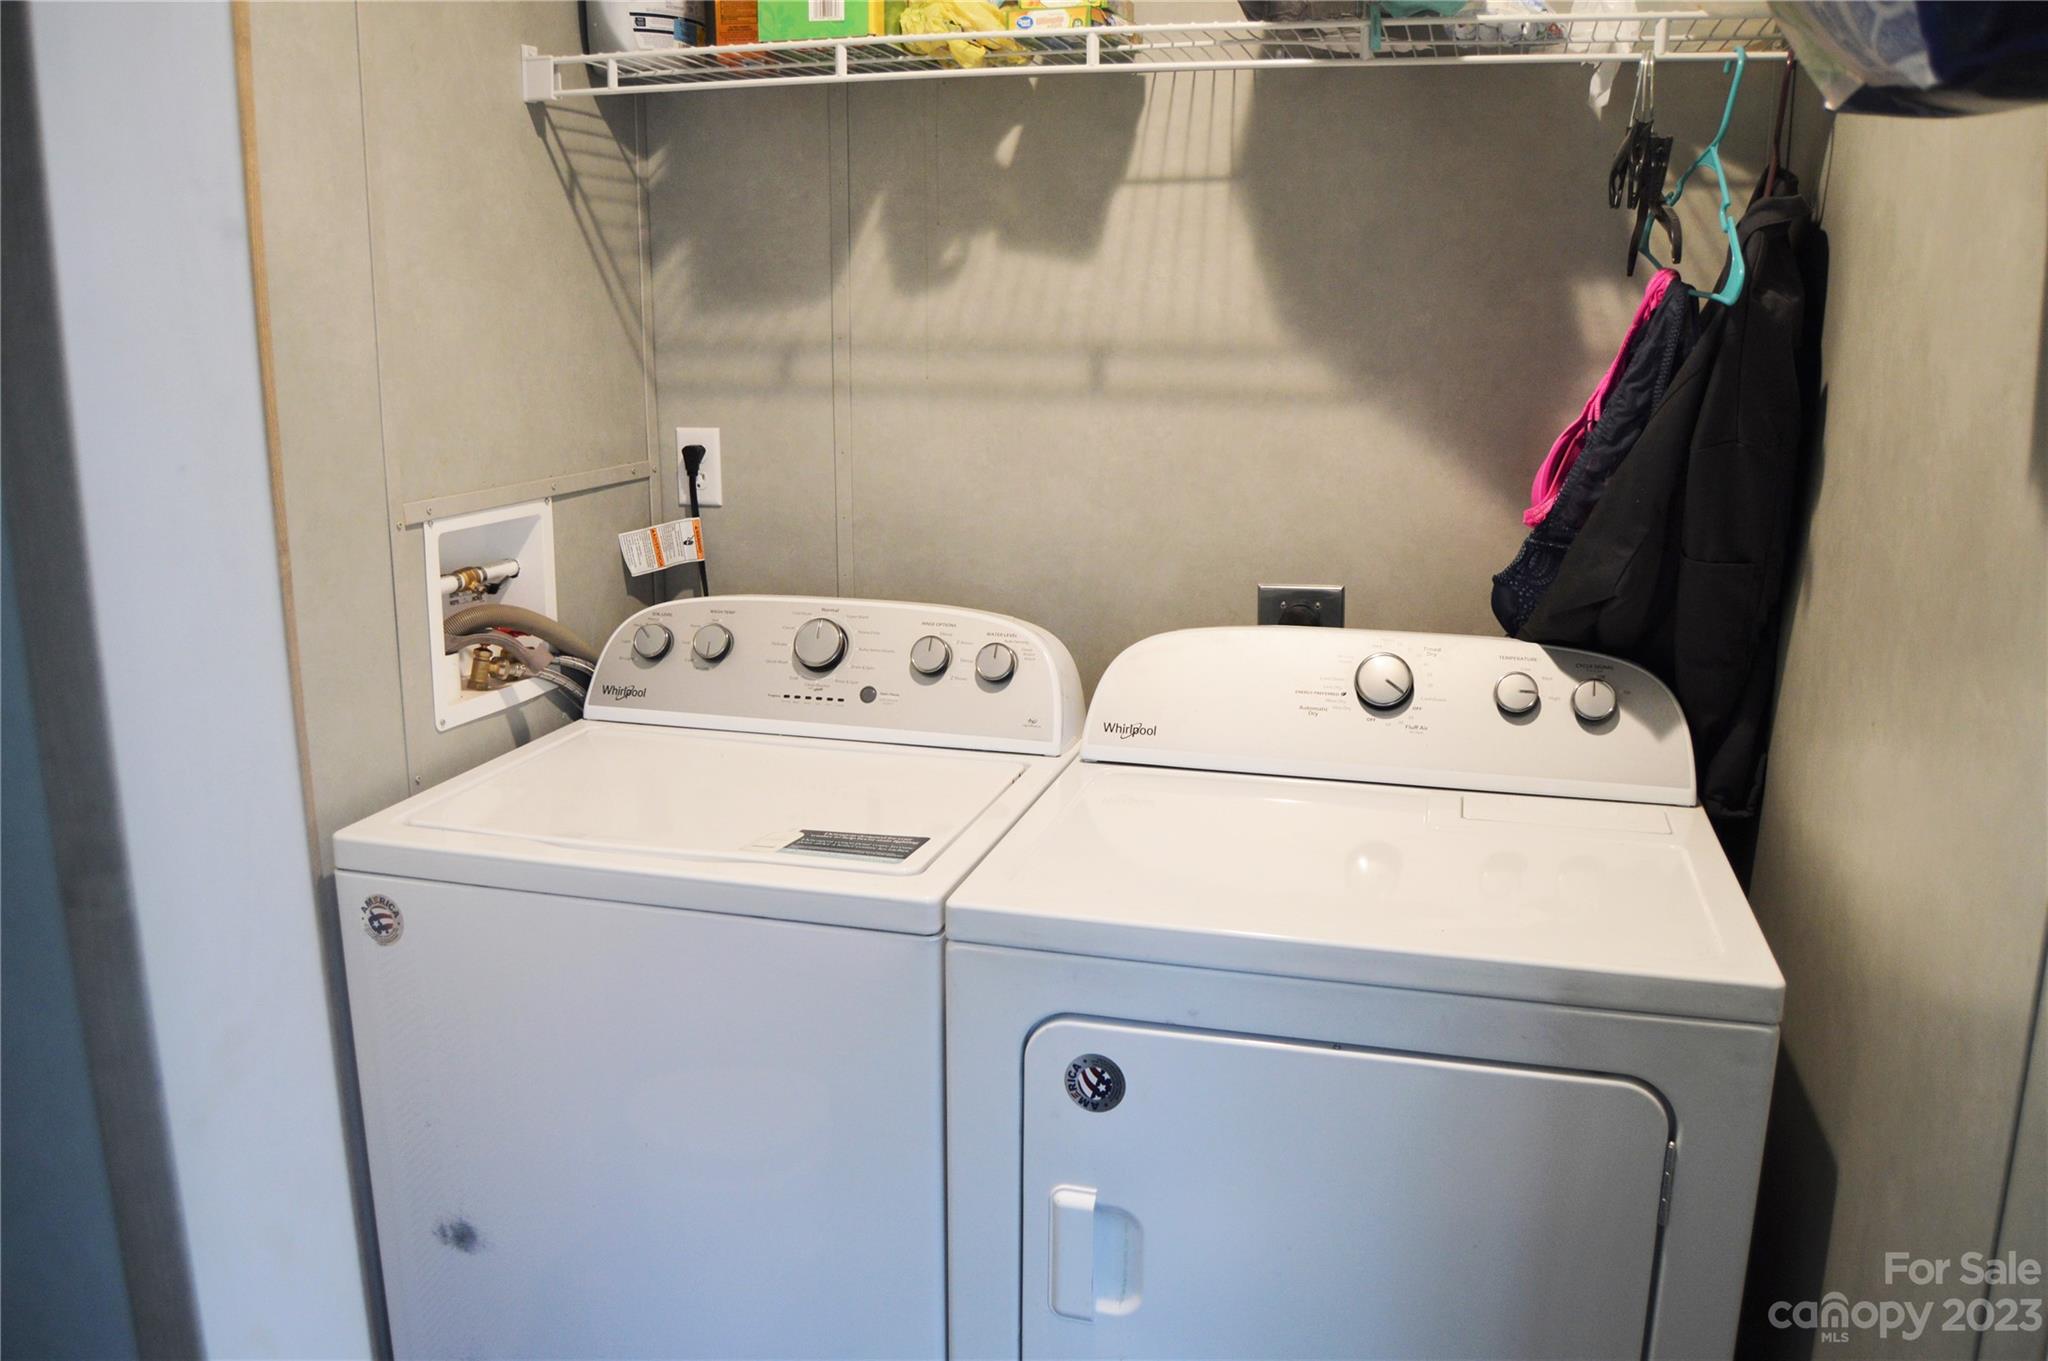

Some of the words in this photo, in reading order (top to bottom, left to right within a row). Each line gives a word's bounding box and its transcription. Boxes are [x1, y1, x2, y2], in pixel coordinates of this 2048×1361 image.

[602, 685, 647, 700] Whirlpool
[1103, 721, 1157, 739] Whirlpool
[361, 896, 399, 918] AMERICA
[1066, 1063, 1100, 1110] AMERICA
